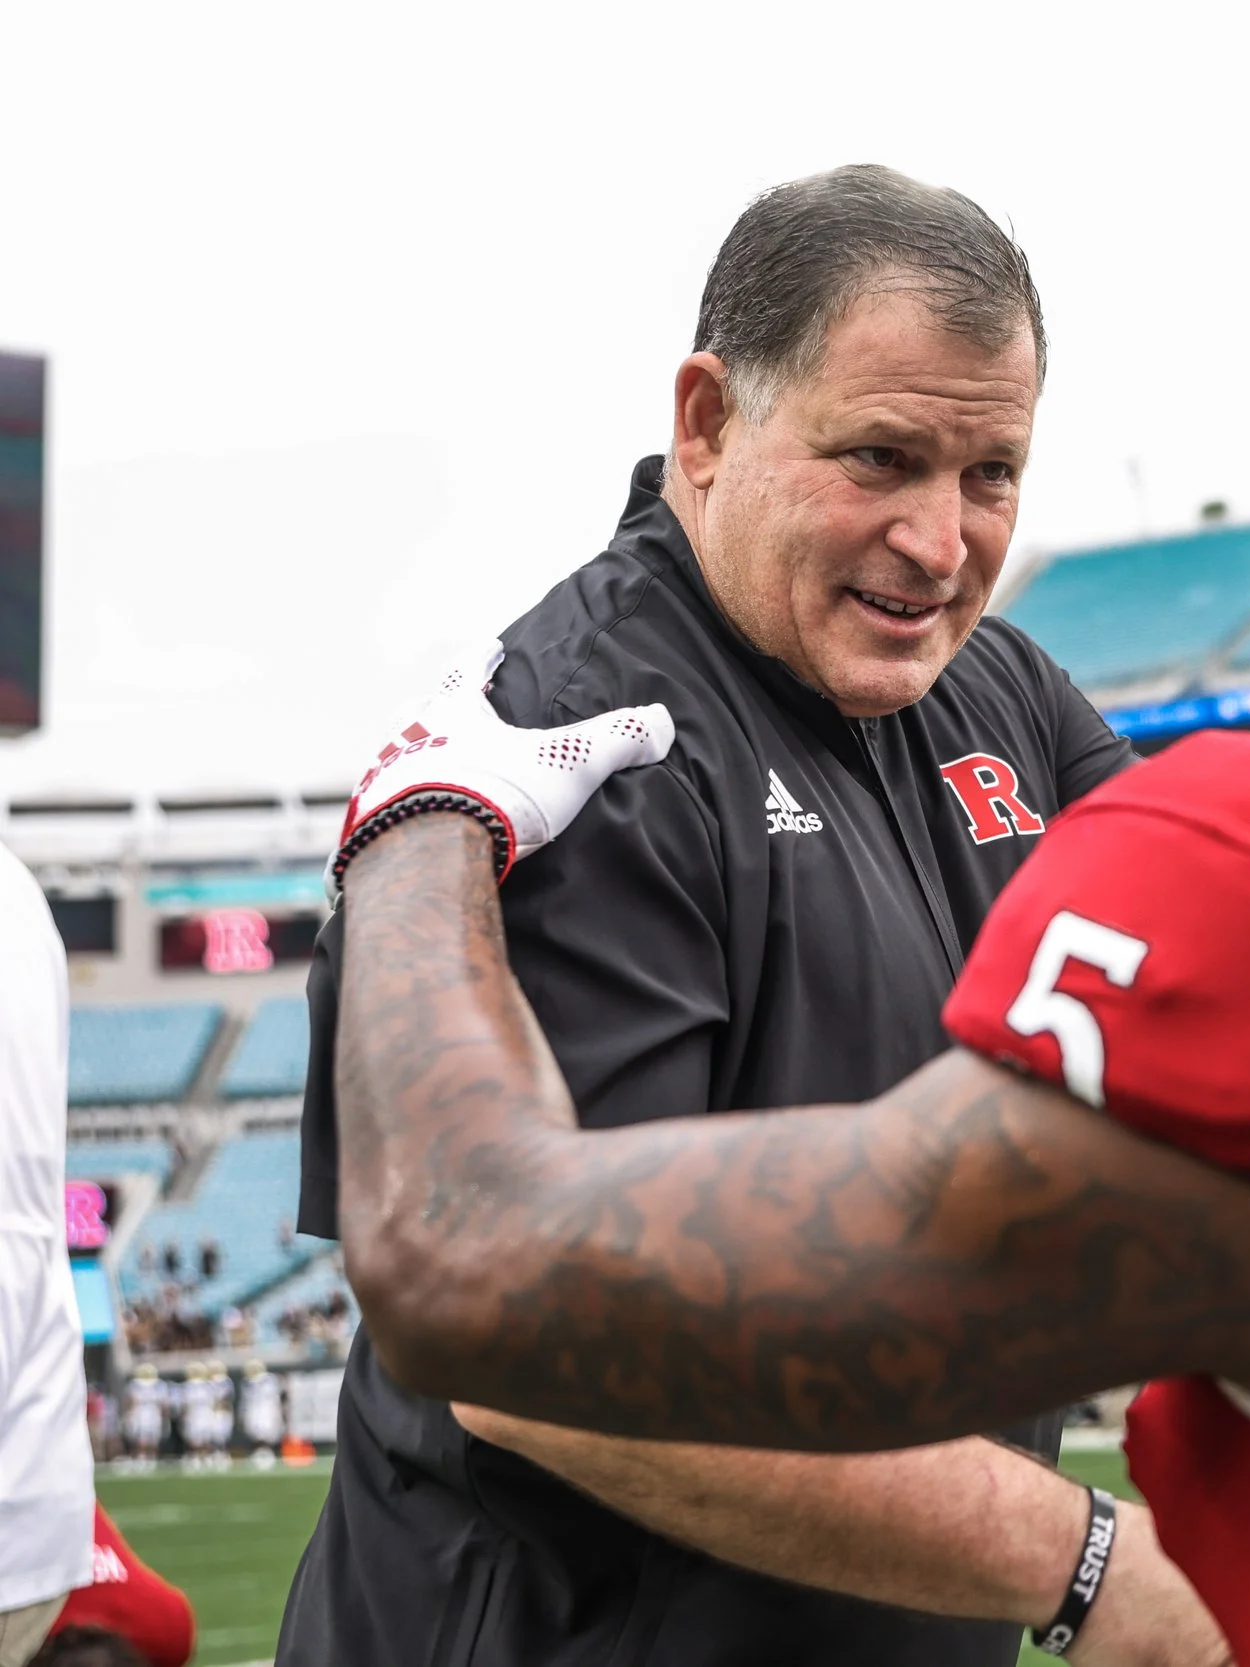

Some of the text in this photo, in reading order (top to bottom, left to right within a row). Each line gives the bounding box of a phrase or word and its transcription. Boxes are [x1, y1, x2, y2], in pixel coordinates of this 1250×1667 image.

[360, 736, 449, 794] didas
[939, 752, 1046, 846] R
[766, 808, 824, 834] adidas
[203, 908, 274, 973] R
[1006, 910, 1149, 1109] 5
[1073, 1515, 1115, 1603] TRUST
